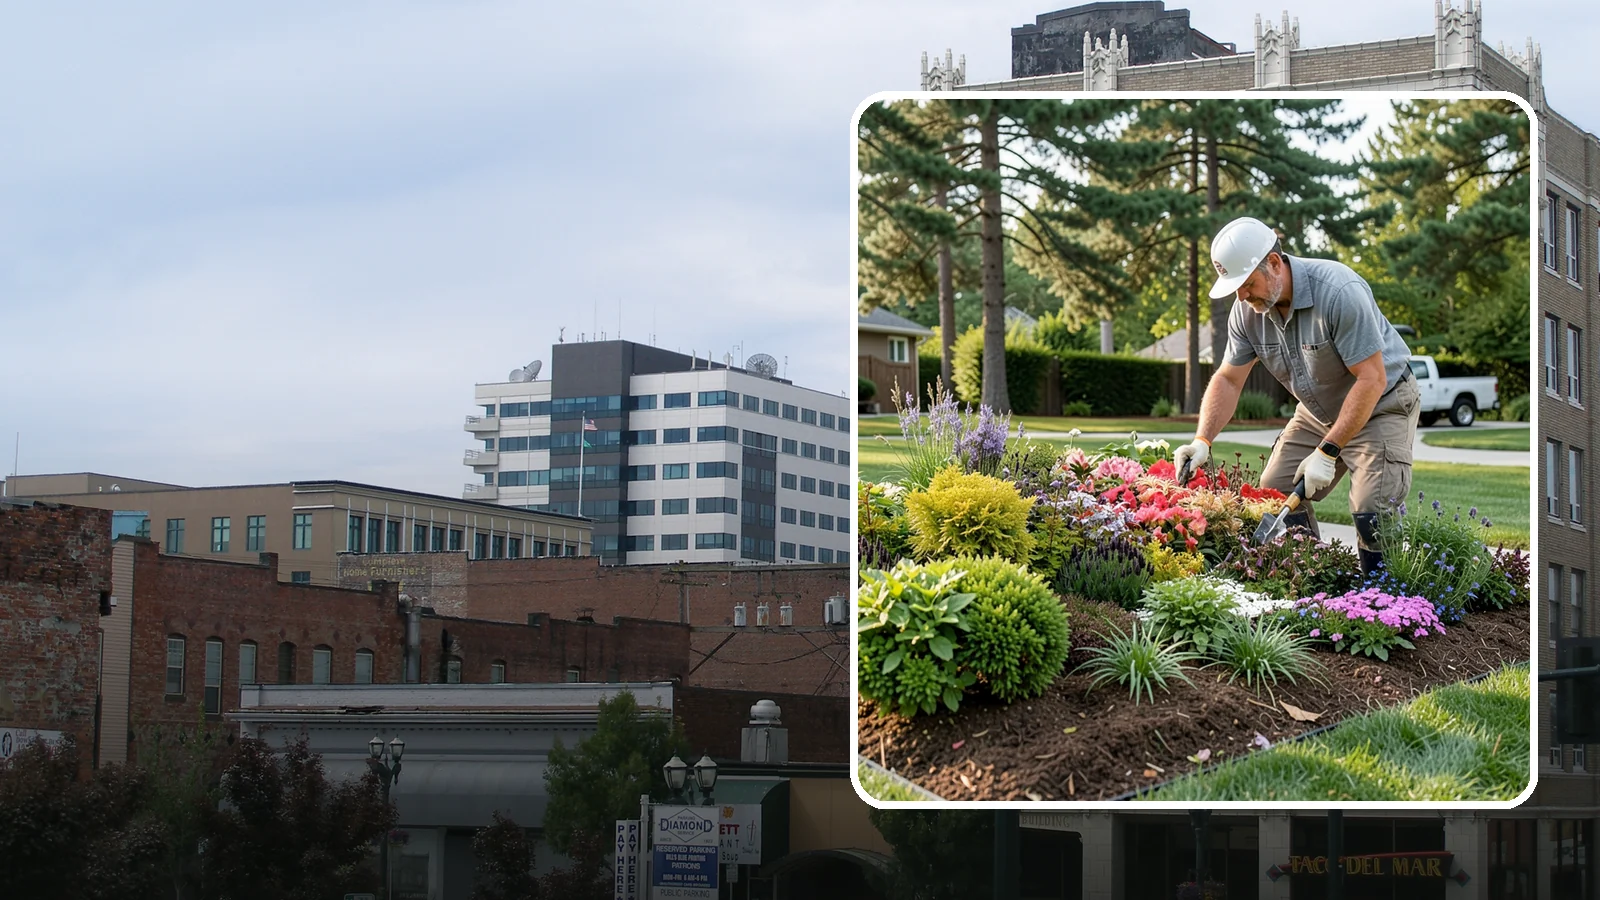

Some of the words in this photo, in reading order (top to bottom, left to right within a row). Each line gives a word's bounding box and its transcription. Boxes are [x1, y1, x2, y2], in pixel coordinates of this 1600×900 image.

[660, 818, 713, 832] DIAMOND
[1022, 815, 1070, 828] BUILDING
[617, 824, 625, 852] PAY
[628, 824, 637, 852] PAY
[655, 845, 688, 853] RESERVED
[689, 846, 716, 854] PARKING
[721, 851, 739, 862] Soup
[671, 862, 701, 870] PATRONS
[1289, 855, 1331, 875] TAC
[1346, 856, 1385, 876] DEL
[1392, 857, 1442, 877] MAR
[616, 856, 625, 893] HERE
[627, 855, 636, 893] HERE
[660, 888, 681, 897] PUBLIC
[683, 890, 710, 898] PARKING
